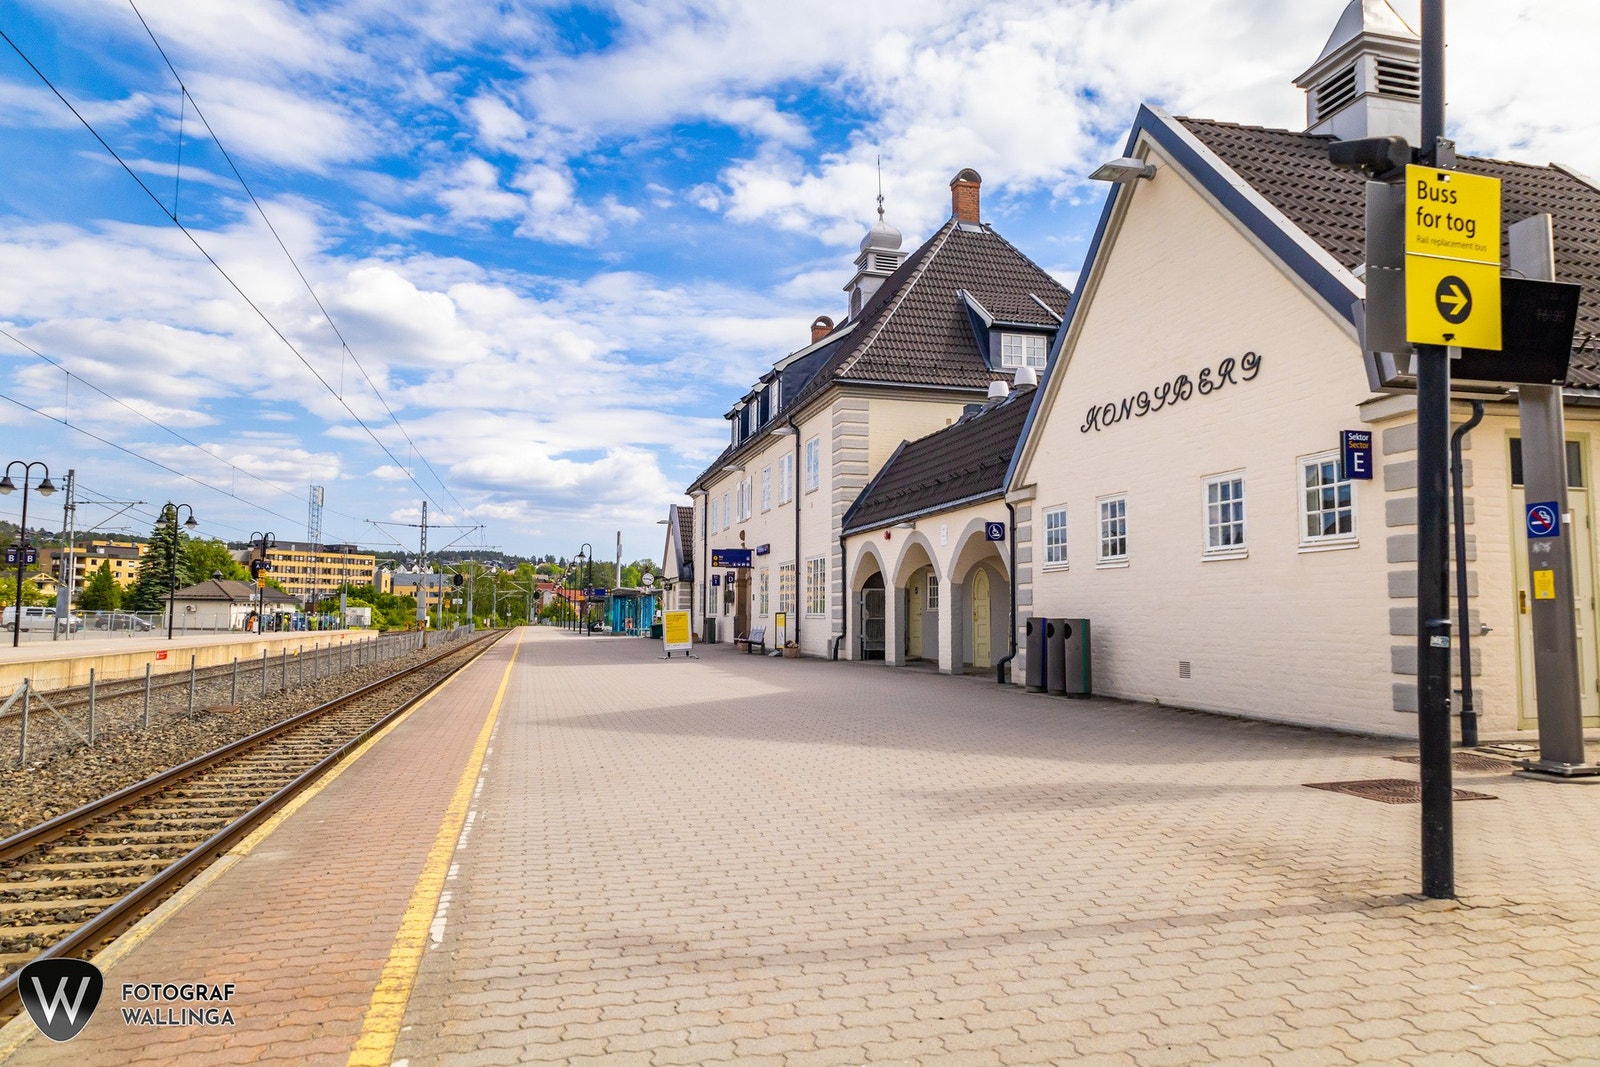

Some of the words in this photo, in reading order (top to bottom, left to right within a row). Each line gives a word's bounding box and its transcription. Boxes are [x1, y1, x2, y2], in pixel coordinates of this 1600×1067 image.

[1417, 180, 1457, 204] Buss
[1416, 206, 1442, 229] for
[1446, 213, 1476, 238] tog
[1416, 234, 1429, 244] Rail
[1430, 237, 1473, 250] replacement
[1474, 242, 1487, 252] bus
[1080, 351, 1262, 433] KONGSBERG
[1348, 432, 1370, 441] Sektor
[1354, 452, 1365, 472] E
